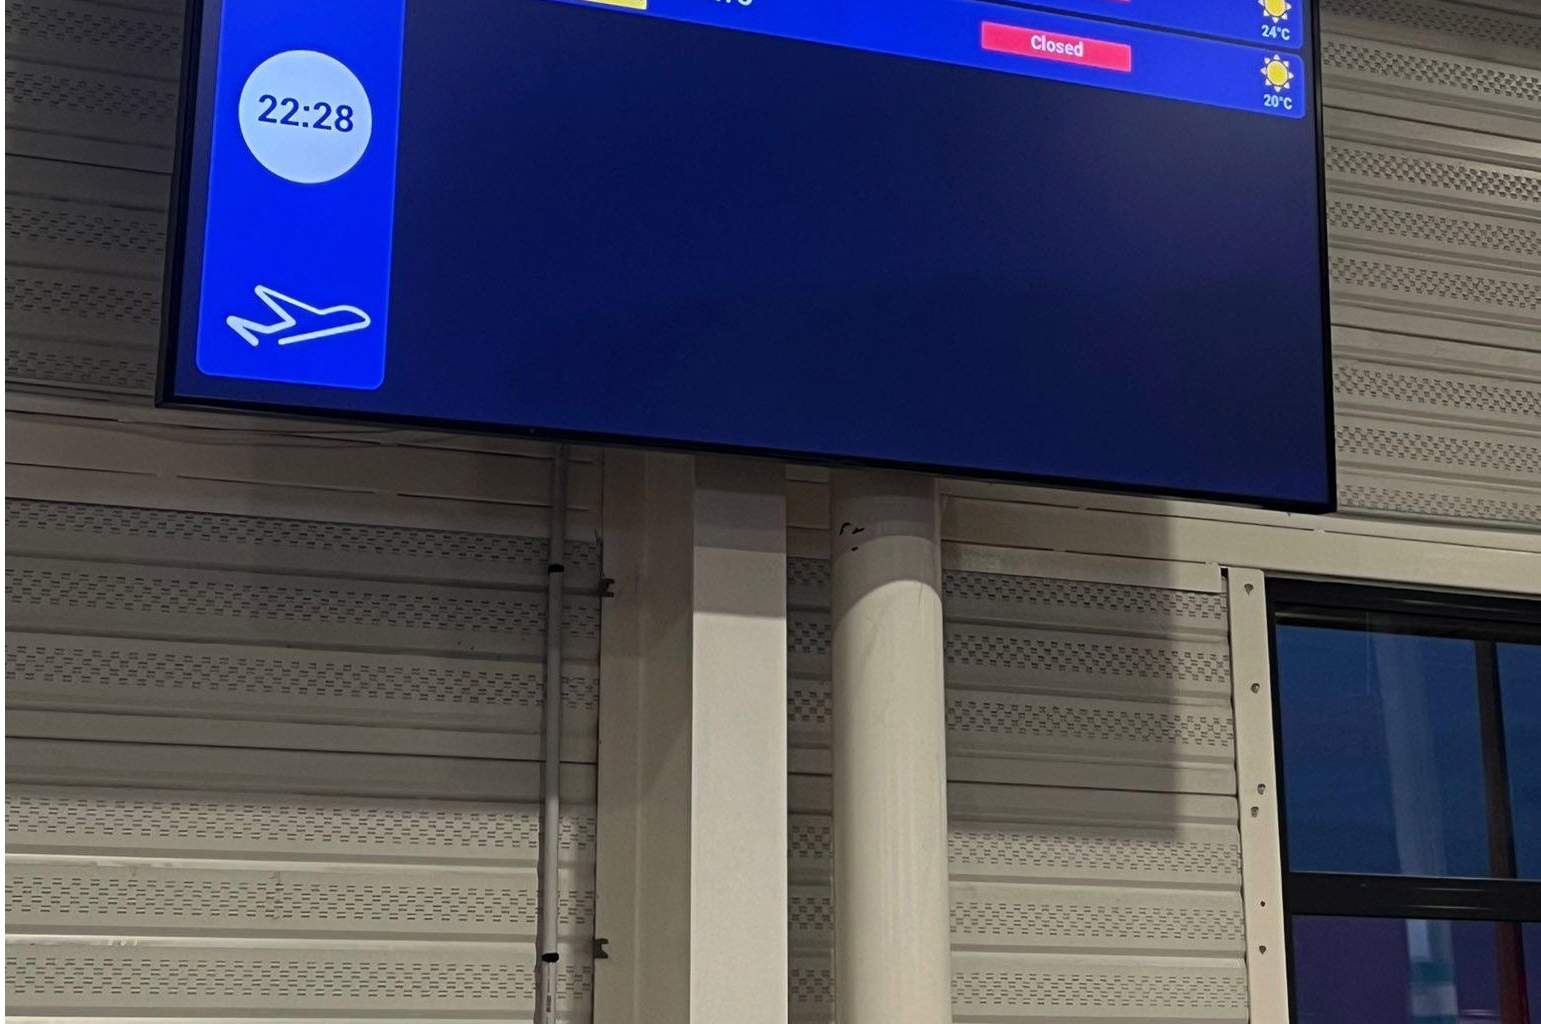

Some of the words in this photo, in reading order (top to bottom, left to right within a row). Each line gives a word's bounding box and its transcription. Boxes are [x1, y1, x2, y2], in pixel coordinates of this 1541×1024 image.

[1261, 24, 1291, 41] 24°C
[1030, 34, 1084, 58] Closed
[1263, 94, 1293, 110] 20°C
[257, 94, 354, 133] 22:28
